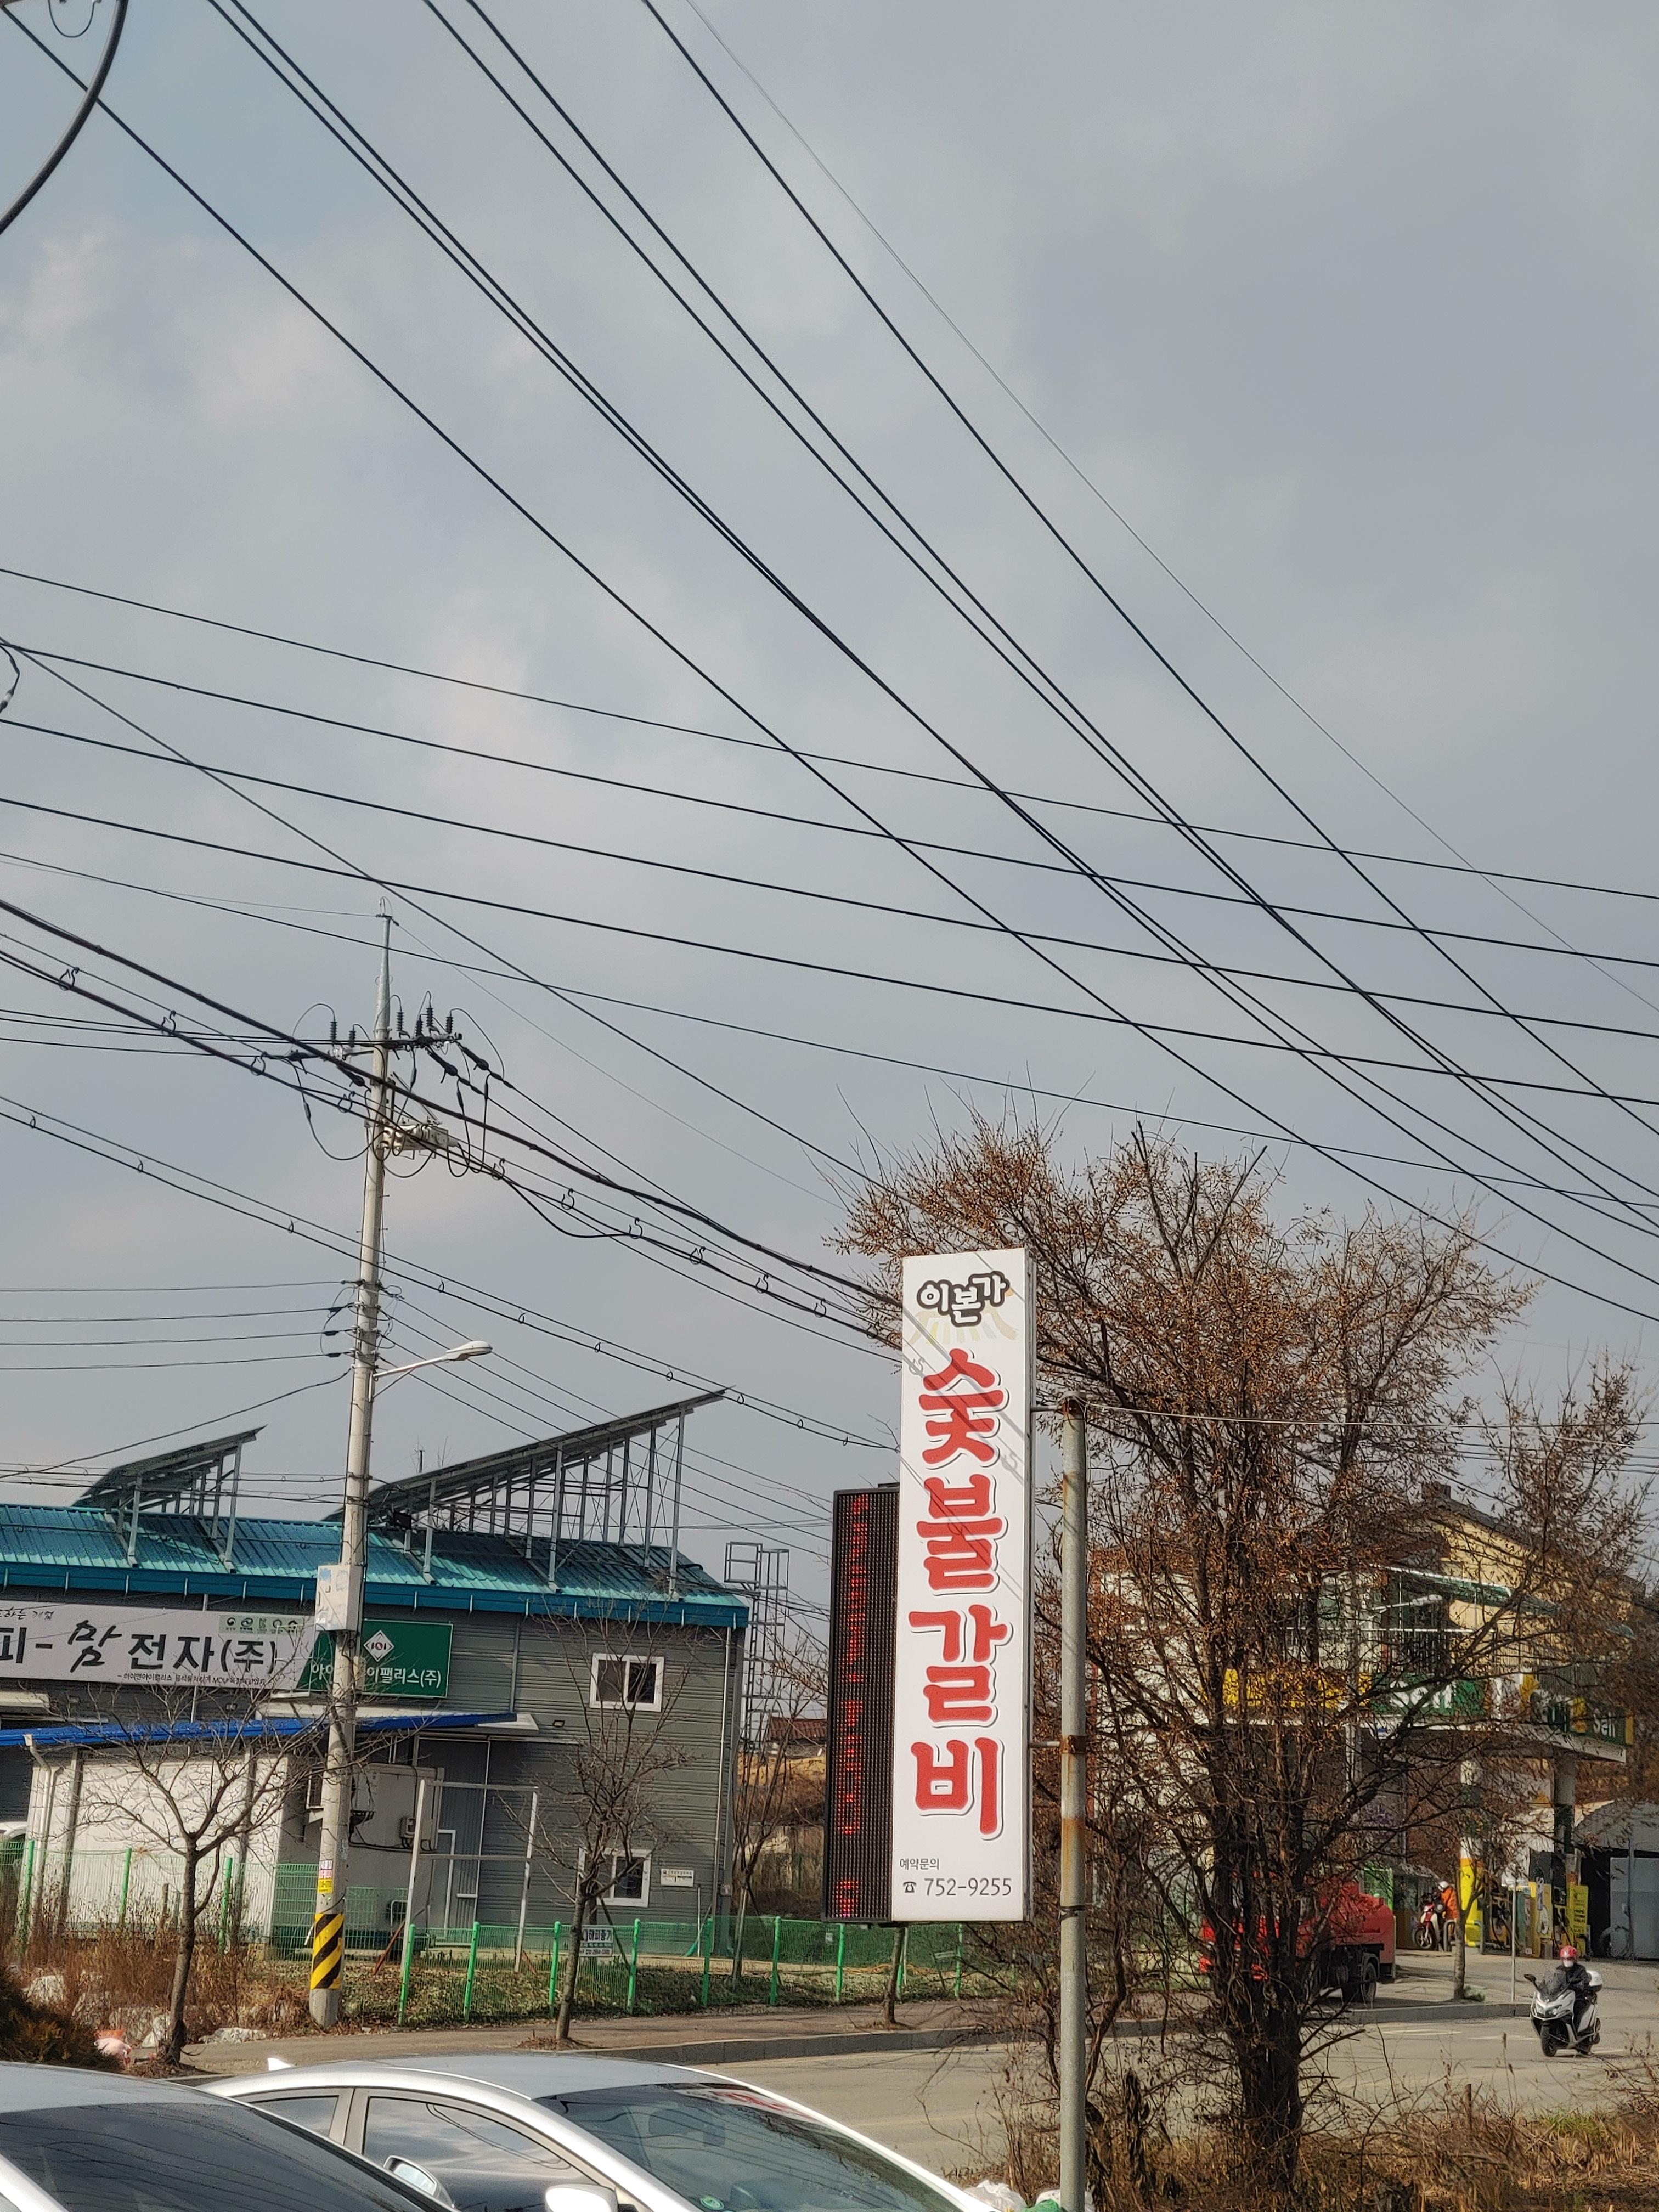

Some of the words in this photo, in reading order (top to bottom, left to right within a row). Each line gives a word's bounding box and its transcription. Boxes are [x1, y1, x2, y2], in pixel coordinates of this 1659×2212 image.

[917, 1271, 1010, 1328] 이본가
[907, 1348, 1008, 1835] 숯불갈비
[899, 1858, 939, 1870] 예약문의
[924, 1877, 1012, 1897] 752-9255
